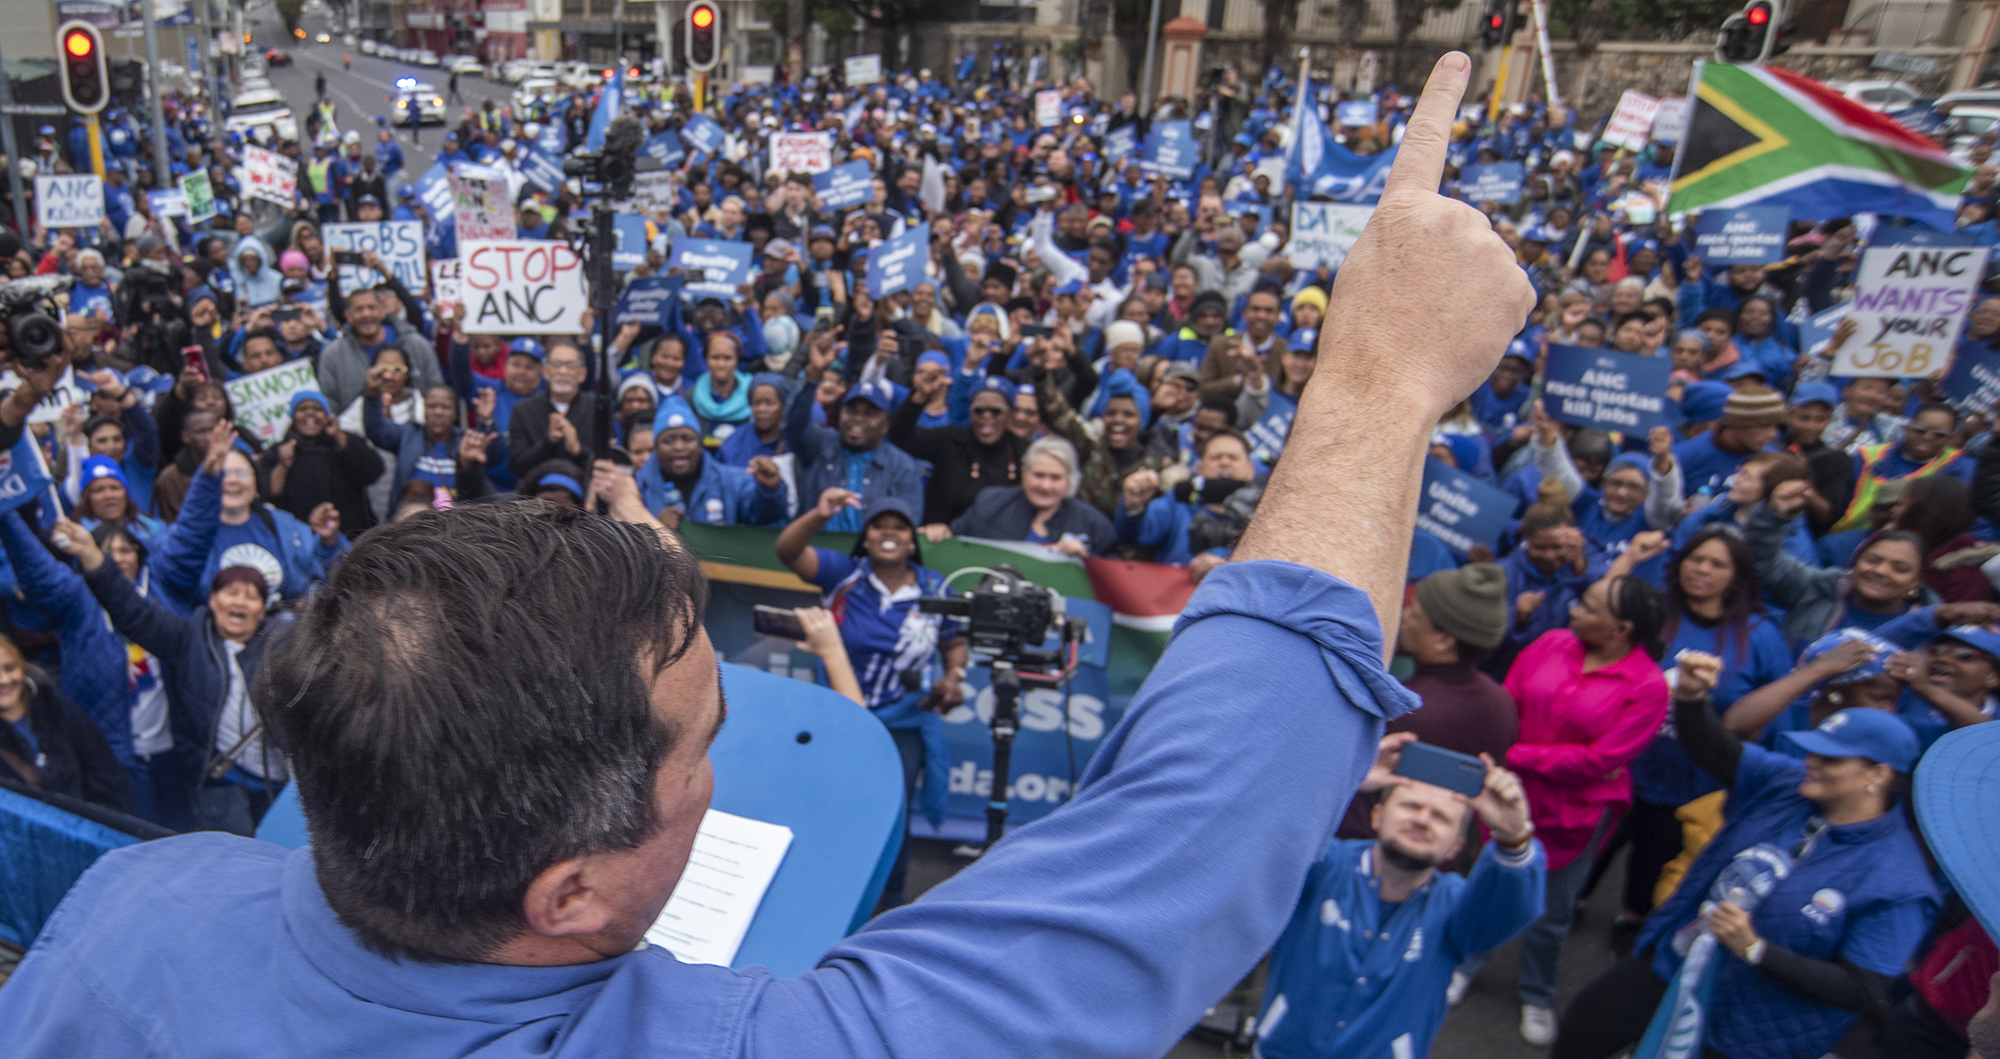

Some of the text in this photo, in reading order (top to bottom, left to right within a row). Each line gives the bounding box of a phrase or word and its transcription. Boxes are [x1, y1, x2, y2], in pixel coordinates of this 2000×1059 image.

[47, 179, 98, 200] ANC
[1296, 204, 1329, 234] DA
[341, 222, 418, 258] JOBS
[466, 244, 579, 290] STOP
[1883, 251, 1972, 279] ANC
[476, 285, 566, 325] ANC
[1855, 284, 1968, 316] WANTS
[1871, 315, 1951, 344] YOUR
[1850, 342, 1934, 374] JOB
[1580, 368, 1629, 391] ANC
[1545, 380, 1664, 413] race quotas
[1561, 397, 1640, 427] kill jobs
[1427, 480, 1479, 518] Unite
[1429, 501, 1461, 526] for
